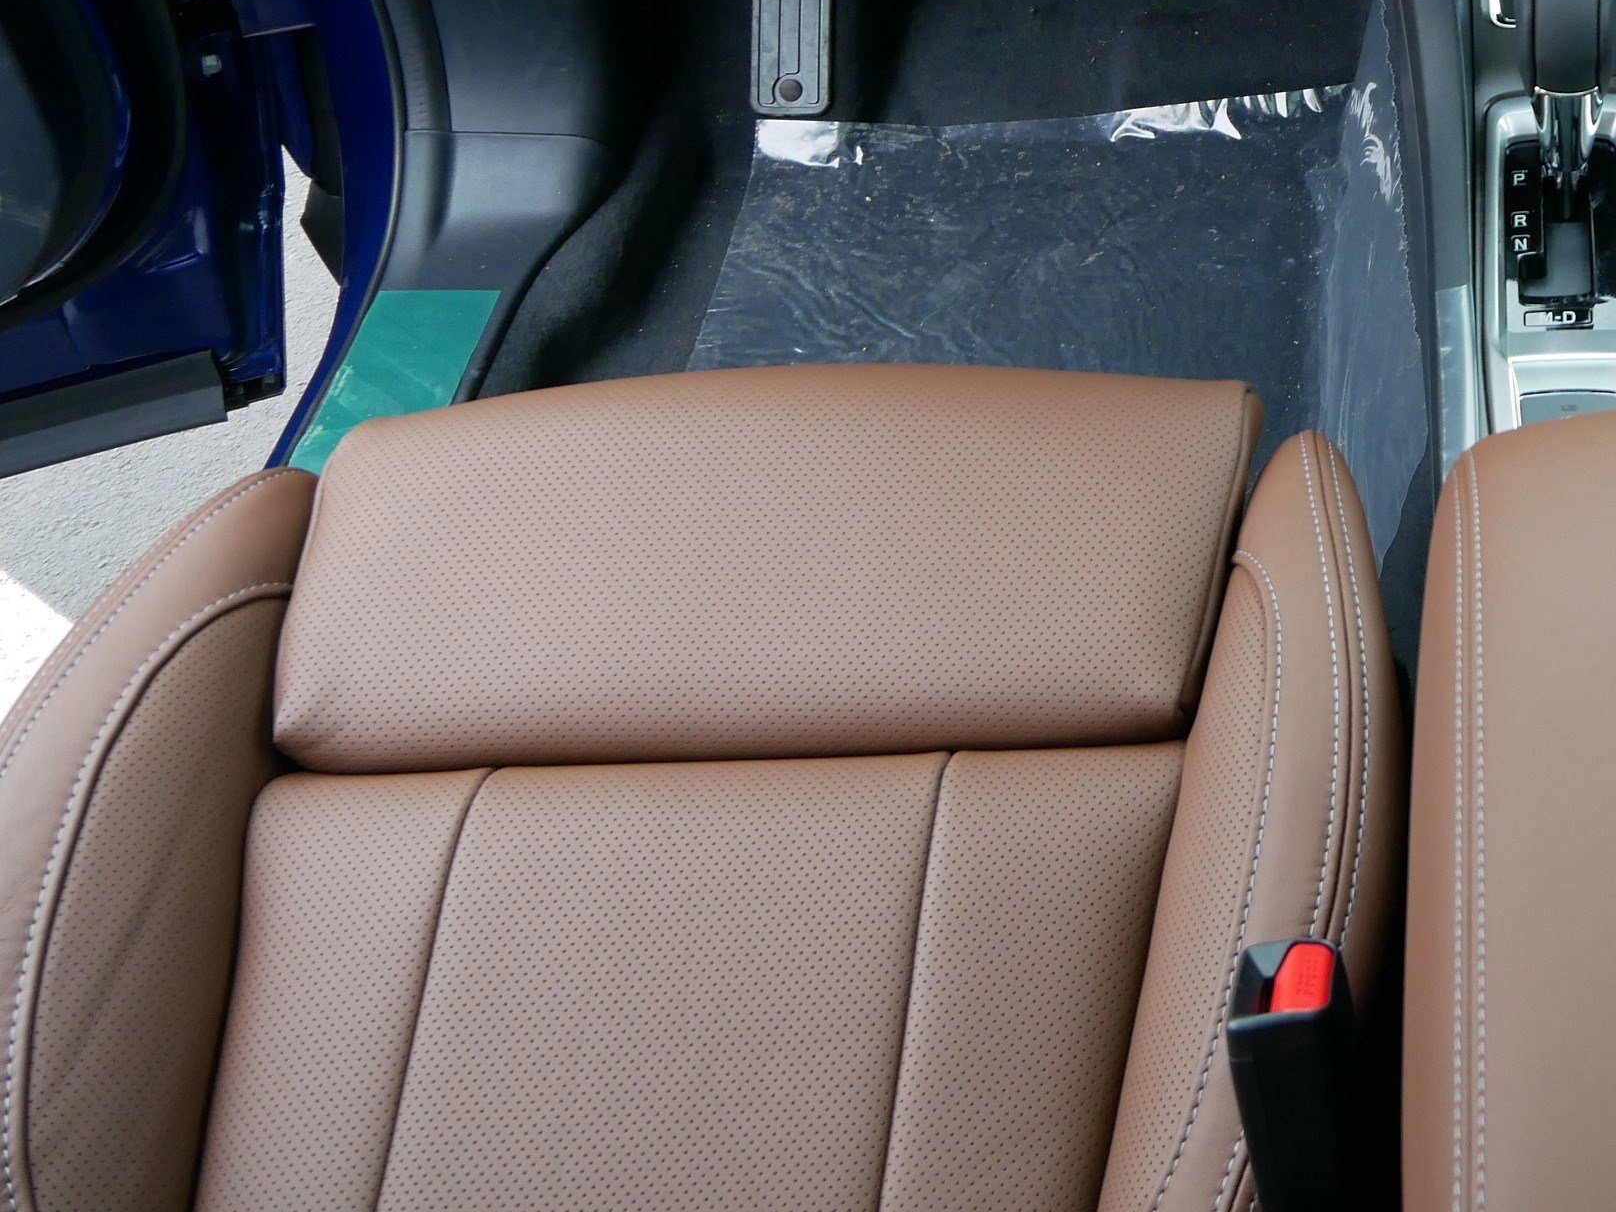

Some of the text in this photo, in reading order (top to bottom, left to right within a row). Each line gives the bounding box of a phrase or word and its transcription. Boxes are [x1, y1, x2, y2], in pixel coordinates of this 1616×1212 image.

[1513, 173, 1526, 186] P
[1513, 214, 1528, 228] R
[1514, 238, 1528, 251] N
